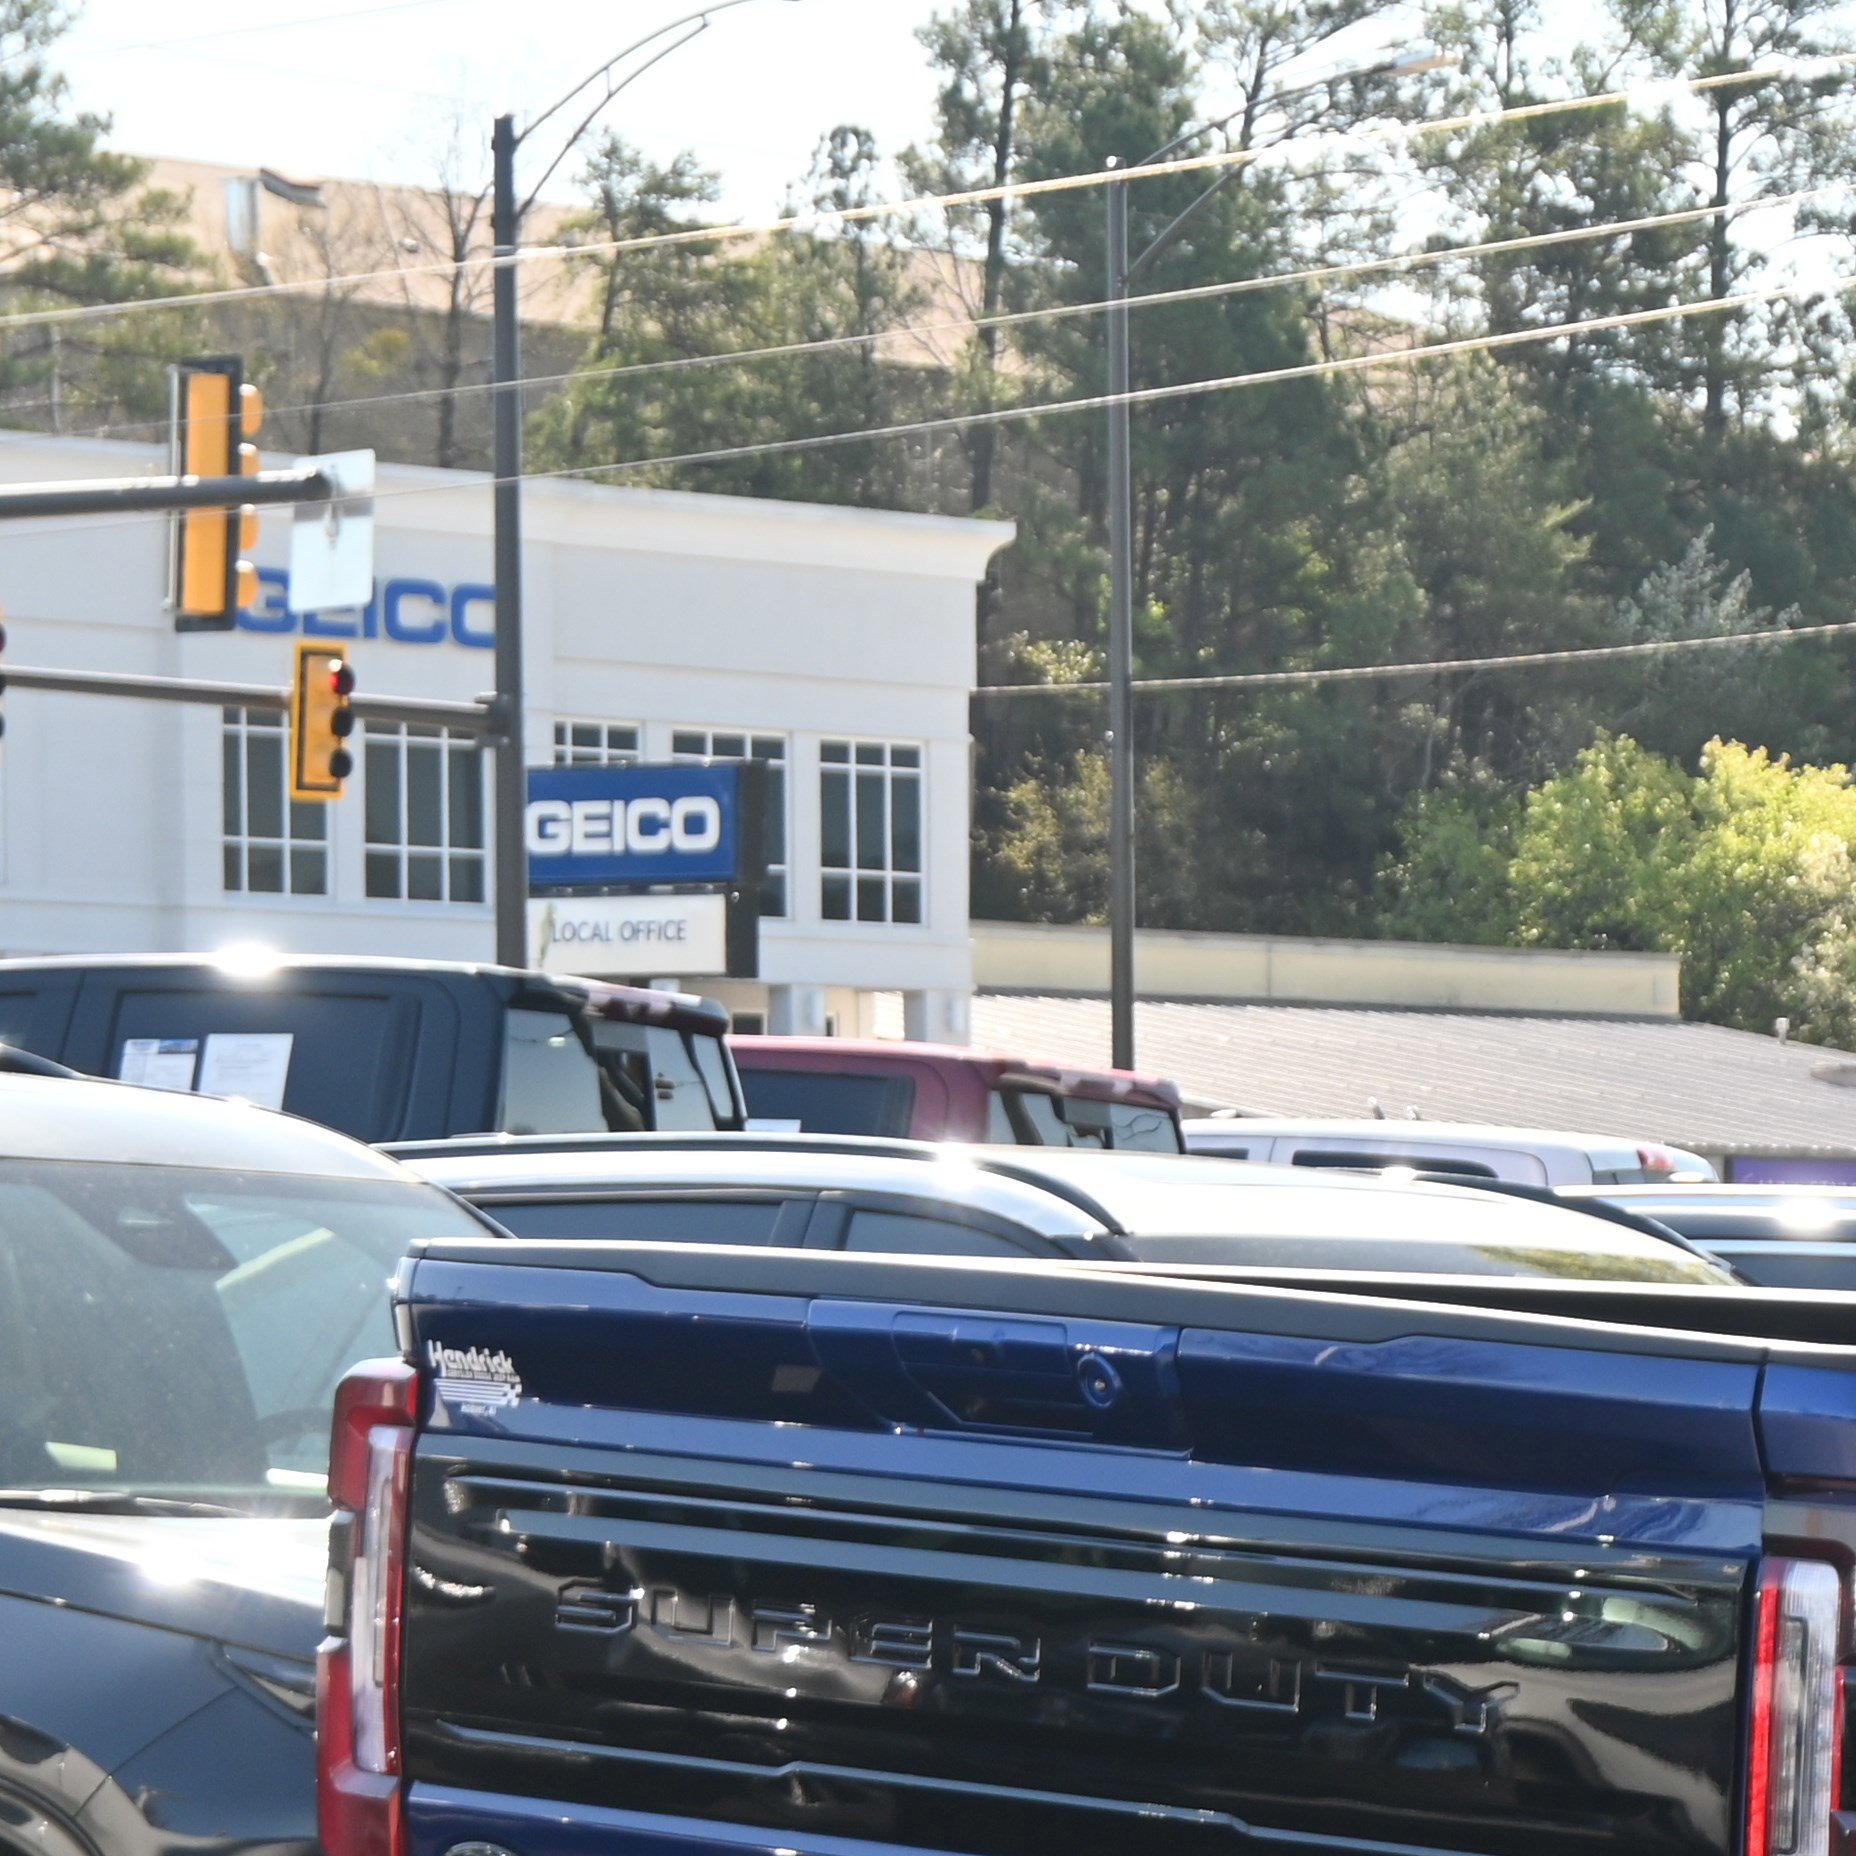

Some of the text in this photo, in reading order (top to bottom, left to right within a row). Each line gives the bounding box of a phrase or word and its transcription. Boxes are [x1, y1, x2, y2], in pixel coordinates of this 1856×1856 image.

[526, 796, 720, 853] GEICO
[552, 919, 687, 942] LOCAL OFFICE
[428, 1339, 516, 1377] Hendrick
[555, 1576, 1521, 1734] SUPER DUTY
